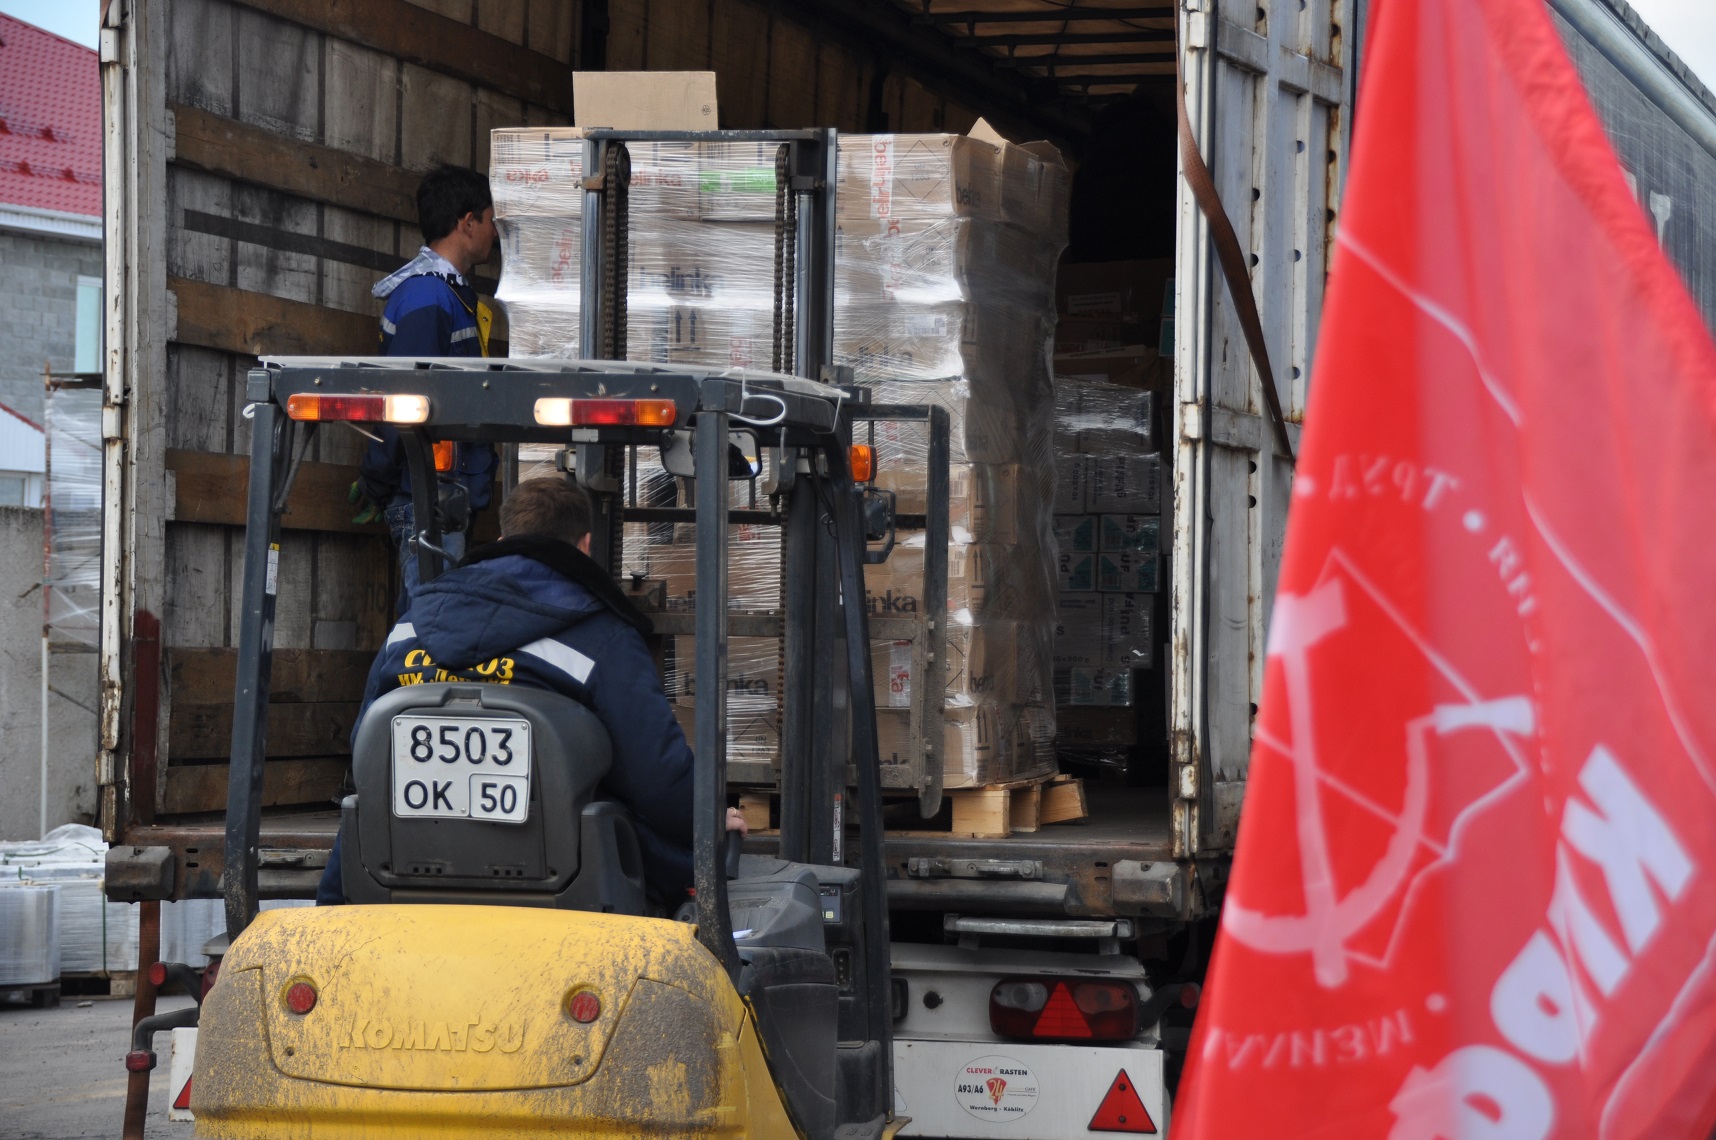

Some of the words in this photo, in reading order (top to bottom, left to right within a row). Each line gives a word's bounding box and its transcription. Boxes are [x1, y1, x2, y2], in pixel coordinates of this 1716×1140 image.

[410, 725, 513, 766] 8503
[480, 782, 517, 814] 50
[339, 1013, 526, 1054] KOMATSU
[999, 1068, 1028, 1076] RASTEN
[957, 1084, 984, 1094] A93/A6
